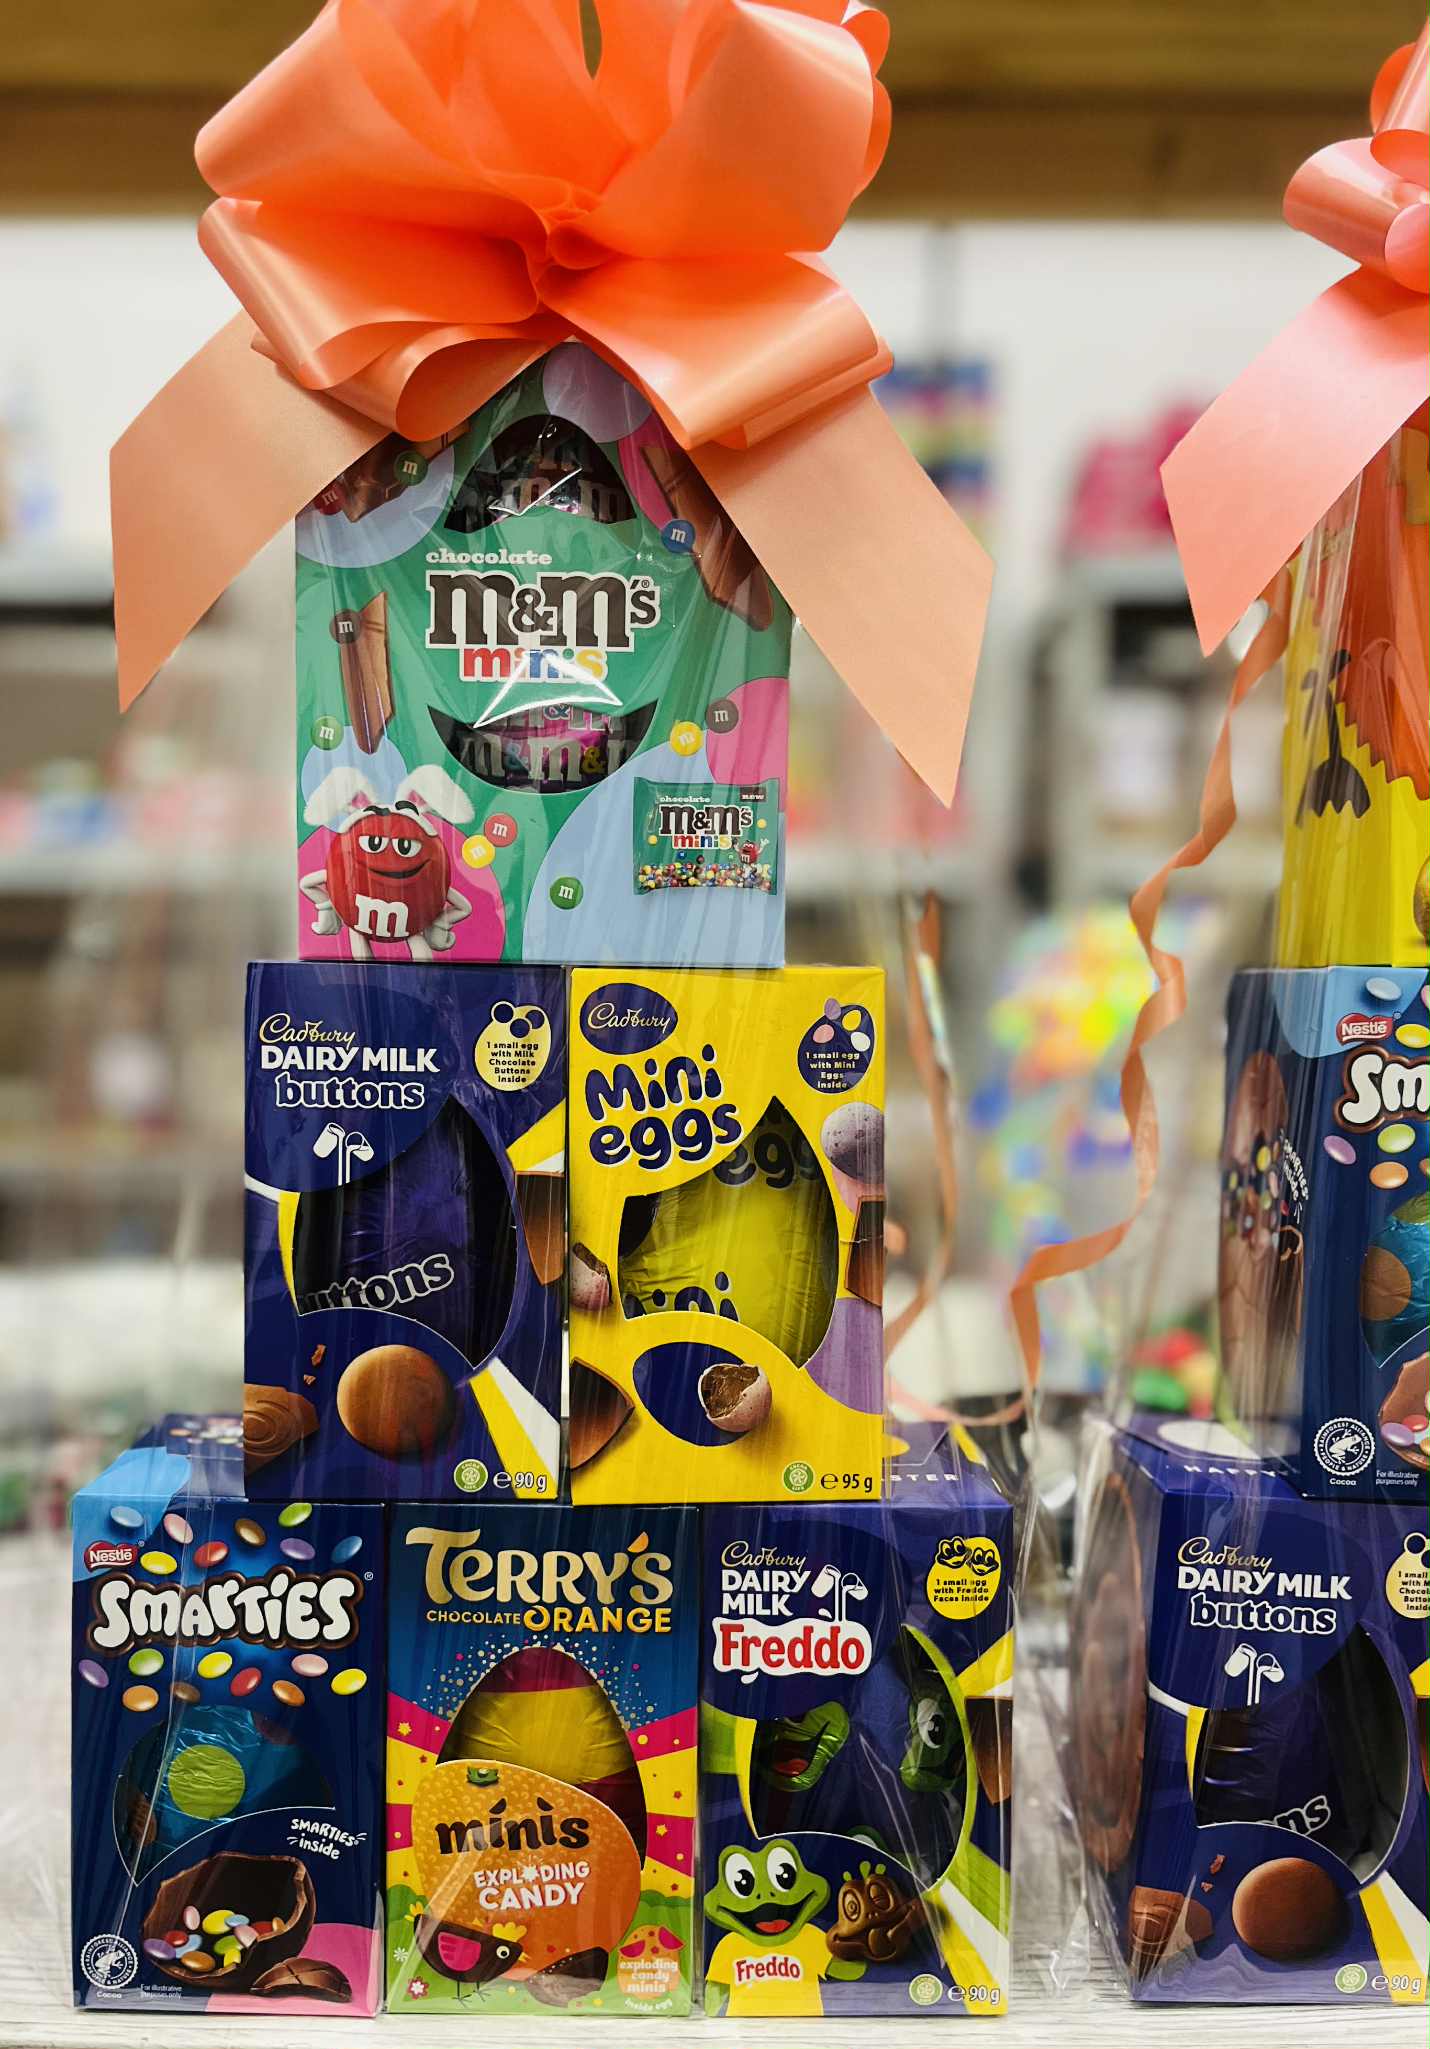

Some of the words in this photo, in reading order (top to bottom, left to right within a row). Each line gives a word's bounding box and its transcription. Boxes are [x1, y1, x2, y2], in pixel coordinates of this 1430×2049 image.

[426, 548, 552, 565] chocolate
[660, 795, 710, 803] chocolate
[673, 834, 732, 848] minis
[354, 894, 410, 938] m
[588, 1002, 671, 1033] Cadbury
[259, 1013, 356, 1050] Cadbury
[494, 1041, 519, 1049] small
[812, 1051, 839, 1059] small
[841, 1052, 860, 1061] egg
[261, 1045, 359, 1071] DAIRY
[362, 1048, 441, 1072] MILK
[489, 1058, 536, 1066] Chocolate
[810, 1061, 832, 1069] with
[834, 1061, 856, 1069] Mini
[585, 1043, 723, 1121] Mini
[821, 1071, 844, 1080] Eggs
[275, 1071, 425, 1109] buttons
[589, 1103, 743, 1170] eggs
[515, 1472, 534, 1488] 90
[537, 1475, 547, 1493] g
[842, 1473, 860, 1490] 95
[865, 1477, 873, 1493] g
[881, 1473, 960, 1482] STER
[1329, 1478, 1357, 1486] Cocoa
[722, 1540, 806, 1573] Cadbury
[1177, 1536, 1273, 1574] Cadbury
[721, 1569, 811, 1593] DAIRY
[943, 1578, 967, 1586] small
[1177, 1565, 1275, 1595] DAIRY
[1277, 1572, 1352, 1599] MILK
[722, 1593, 793, 1616] MILK
[1190, 1592, 1337, 1635] buttons
[426, 1609, 521, 1625] CHOCOLATE
[523, 1605, 673, 1633] ORANGE
[719, 1623, 865, 1670] Freddo
[290, 1818, 356, 1847] SMARTIES
[435, 1797, 590, 1855] minis
[298, 1832, 340, 1860] inside
[479, 1881, 585, 1911] CANDY
[620, 1958, 679, 1973] exploding
[736, 1956, 800, 1982] Freddo
[626, 1980, 666, 1993] minis
[969, 1985, 987, 2001] 90
[990, 1988, 1000, 2005] g
[1391, 1975, 1409, 1991] 90
[1411, 1978, 1421, 1994] g
